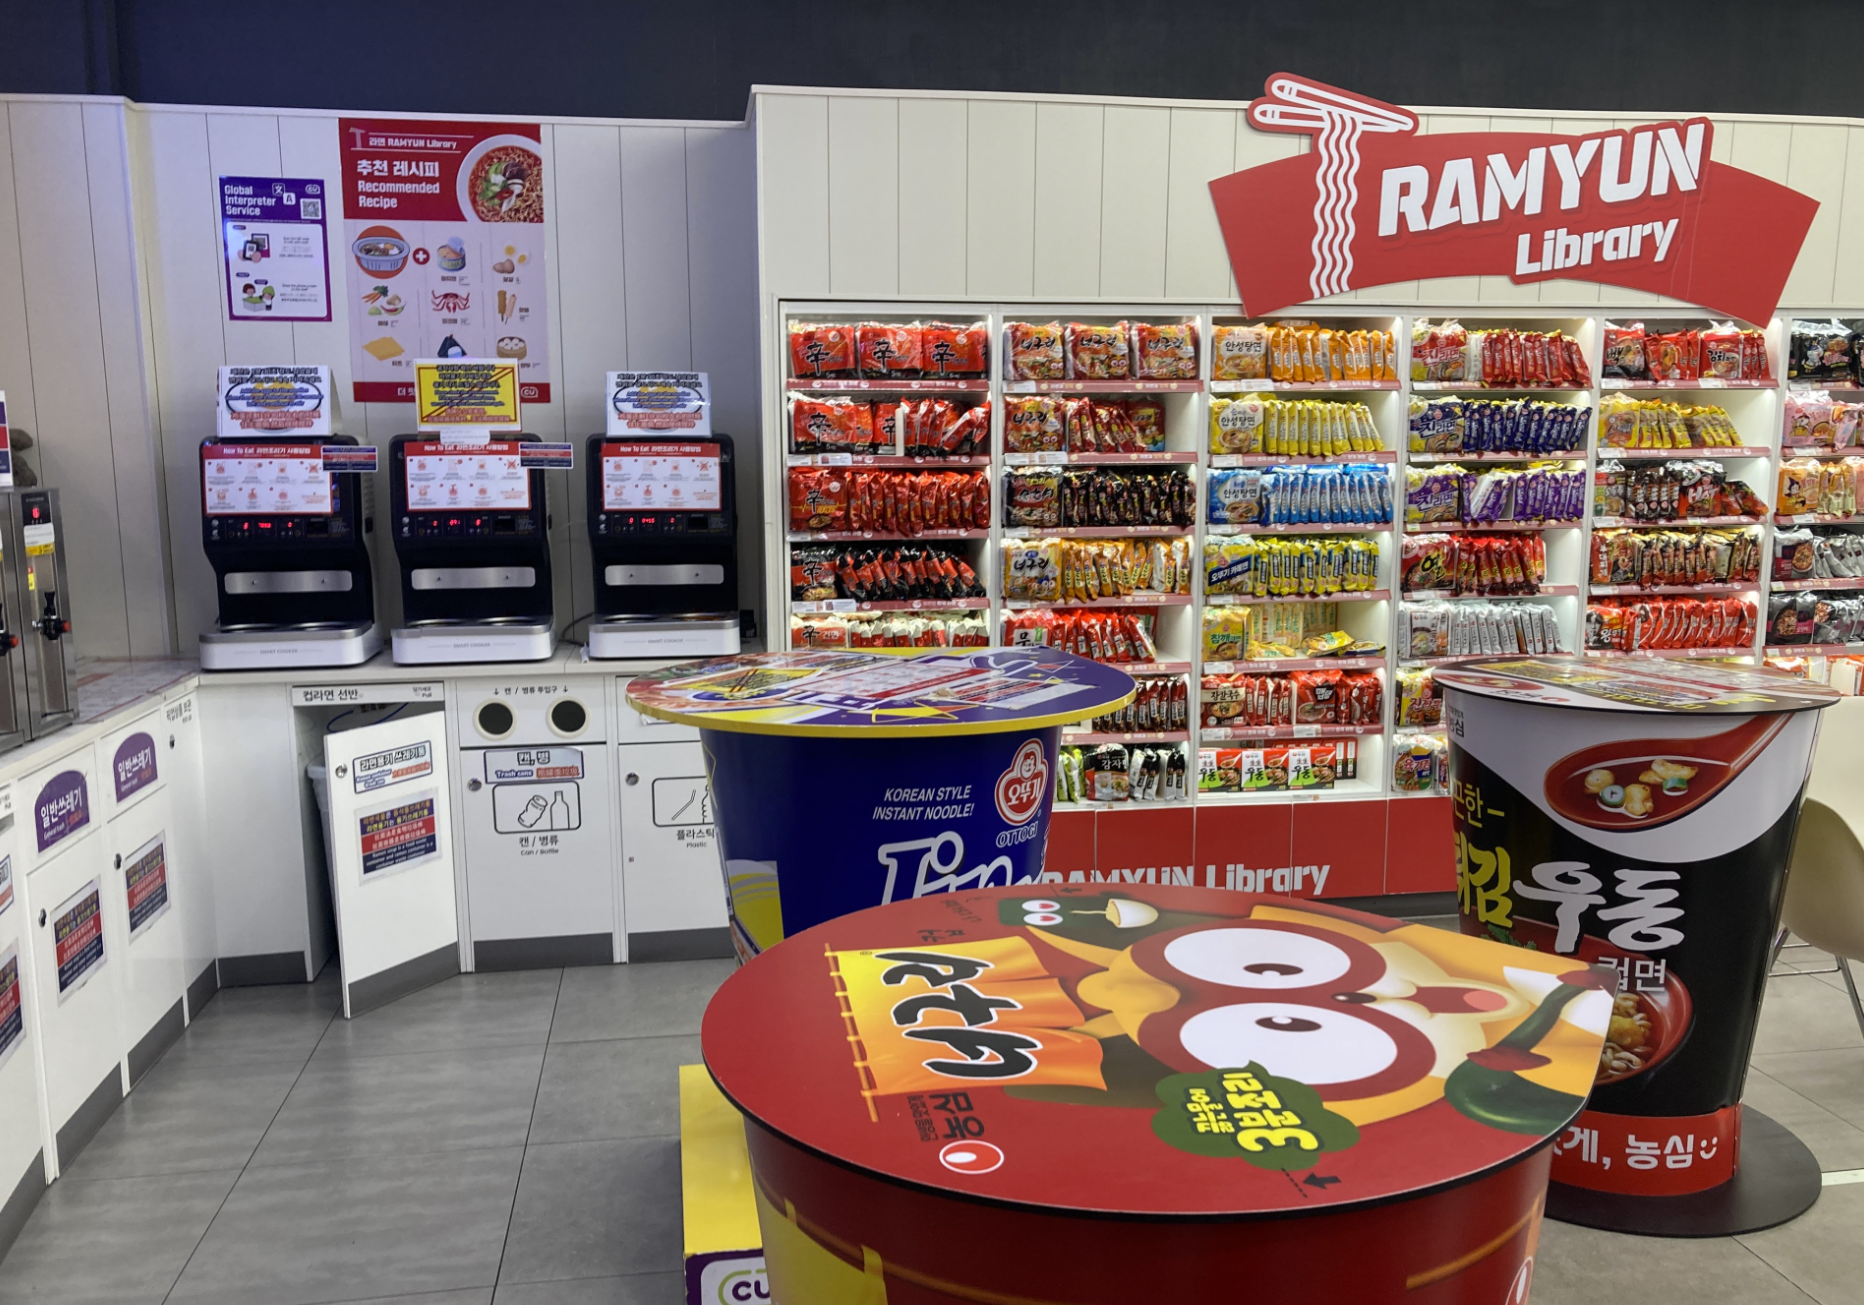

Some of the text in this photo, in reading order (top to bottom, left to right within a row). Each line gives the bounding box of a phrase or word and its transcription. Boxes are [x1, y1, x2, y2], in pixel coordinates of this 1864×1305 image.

[387, 137, 425, 148] RAMYUN
[426, 139, 457, 150] Library
[357, 159, 439, 177] 추천 레시피
[357, 180, 440, 194] Recommended
[1378, 123, 1706, 237] RAMYUN
[224, 184, 254, 195] Global
[225, 195, 276, 206] Interpreter
[358, 195, 398, 209] Recipe
[226, 205, 261, 215] Service
[1515, 218, 1679, 277] Library
[1020, 336, 1056, 350] 너구리
[1080, 335, 1118, 348] 너구리
[1148, 337, 1185, 350] 너구리
[1225, 341, 1262, 352] 안성탕면
[806, 341, 830, 376] 辛
[872, 338, 896, 373] 辛
[932, 340, 956, 376] 辛
[1422, 347, 1460, 367] 진라면
[1013, 411, 1048, 425] 너구리
[1220, 416, 1256, 427] 안성탕면
[807, 412, 832, 445] 辛
[1419, 420, 1457, 438] 진라면
[1223, 487, 1257, 500] 안성탕면
[1417, 493, 1454, 512] 진라면
[1014, 558, 1050, 571] 너구리
[1211, 560, 1249, 582] 오뚜기 카레면
[1210, 633, 1241, 644] 참깨라면
[303, 688, 358, 701] 컵라면 선반
[522, 686, 536, 695] 병류
[537, 685, 558, 694] 투입구
[1210, 689, 1241, 701] 장칼국수
[117, 746, 152, 782] 일반쓰레기
[360, 752, 394, 772] 라면용기
[394, 744, 427, 763] 쓰레기통
[495, 769, 534, 779] Trash cans
[1199, 768, 1216, 783] 우동
[1245, 767, 1265, 782] 우동
[1291, 765, 1312, 780] 우동
[884, 785, 972, 803] KOREAN STYLE
[1007, 776, 1041, 806] 오뚜기
[40, 786, 82, 829] 일반쓰레기
[872, 803, 974, 821] INSTANT NOODLE!
[43, 825, 57, 840] General
[676, 828, 715, 840] 플라스틱
[996, 821, 1039, 848] OTTOGI
[519, 836, 530, 848] 캔
[538, 835, 559, 846] 병류
[686, 840, 707, 848] Plastic
[1205, 864, 1330, 896] Library
[1512, 861, 1685, 954] 우동
[1597, 956, 1668, 993] 컵면
[872, 950, 1045, 1080] 너구리
[928, 1090, 986, 1140] 농심
[1222, 1072, 1320, 1153] 3분조리
[1553, 1128, 1695, 1170] 게, 농심
[731, 1280, 771, 1301] CU
